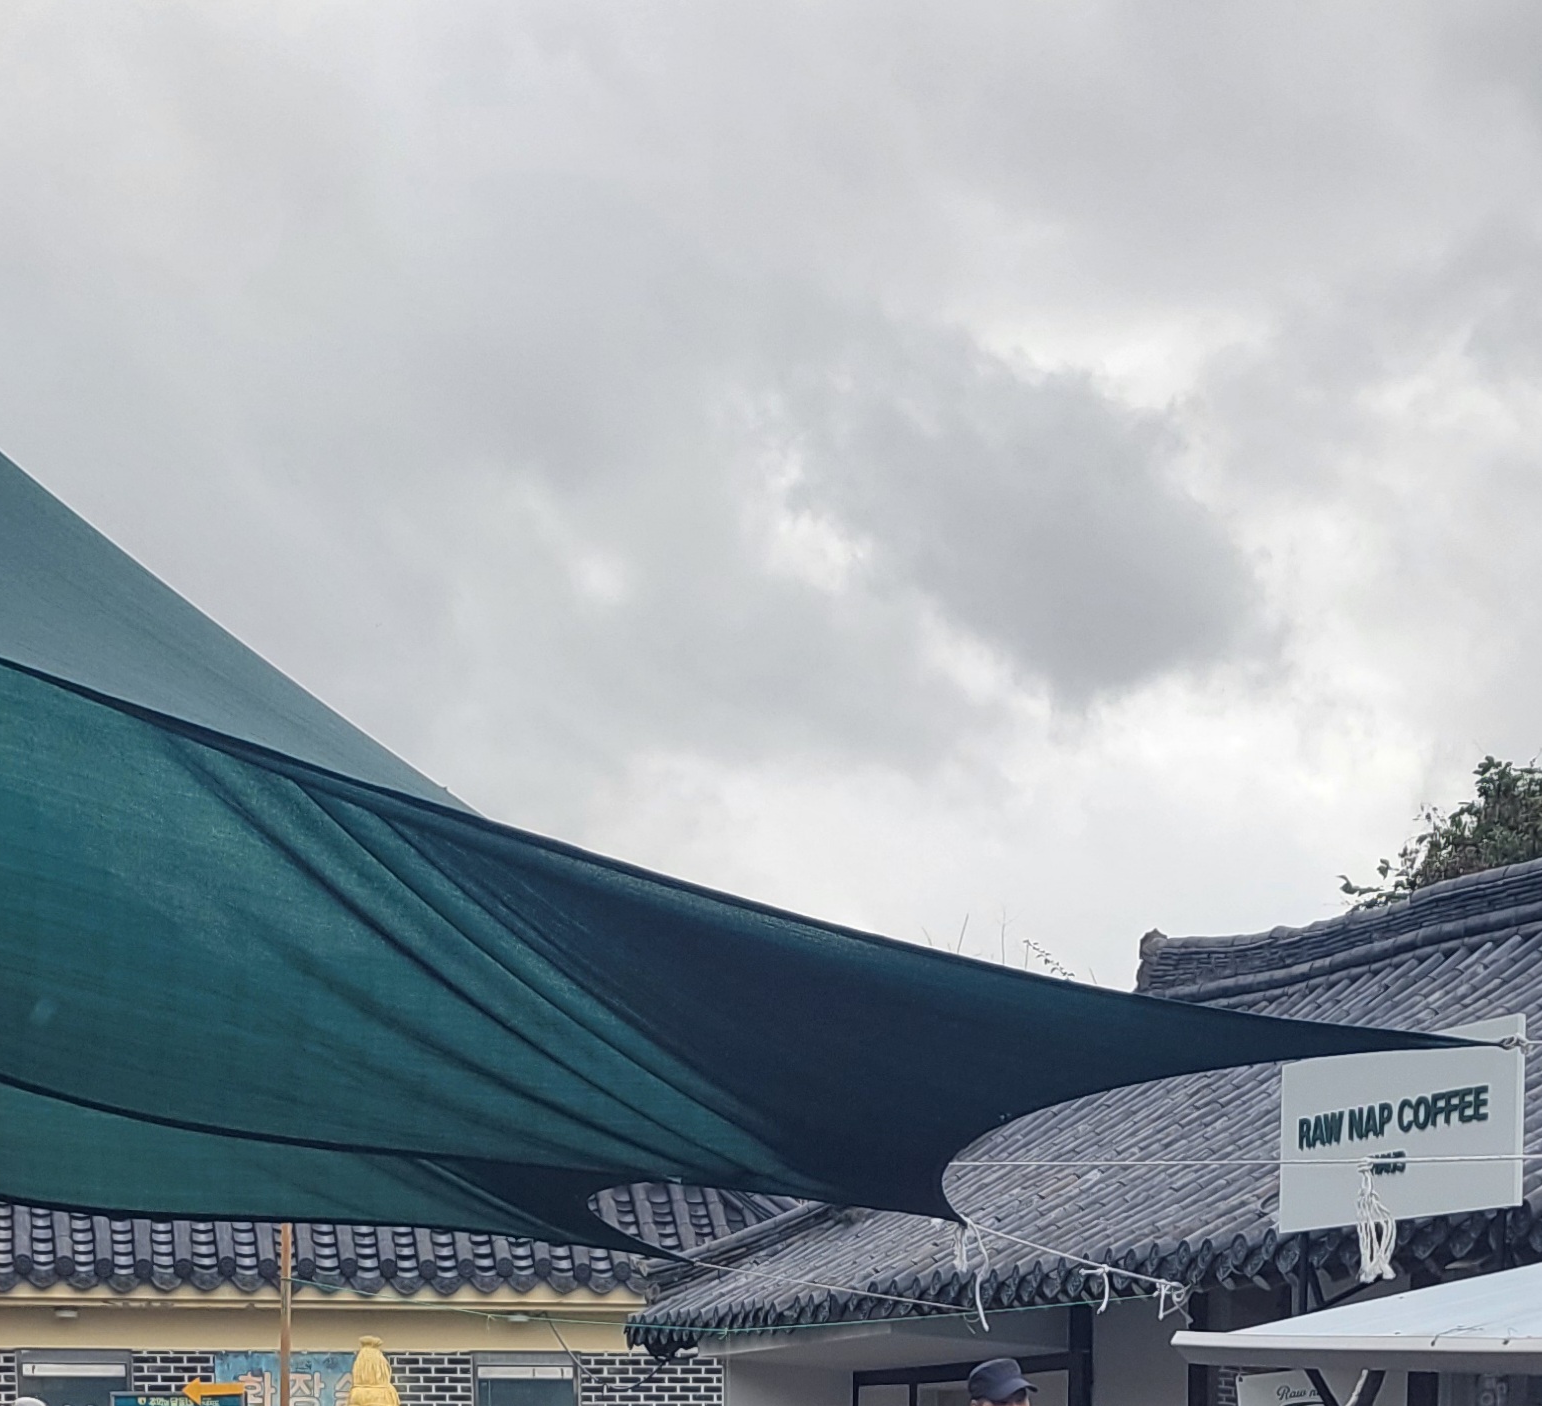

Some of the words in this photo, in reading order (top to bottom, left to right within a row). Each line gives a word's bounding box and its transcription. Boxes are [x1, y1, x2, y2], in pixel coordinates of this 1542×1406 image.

[1298, 1110, 1344, 1150] RAW
[1348, 1102, 1392, 1141] NAP
[1397, 1085, 1489, 1133] COFFEE
[1276, 1385, 1307, 1400] Raw
